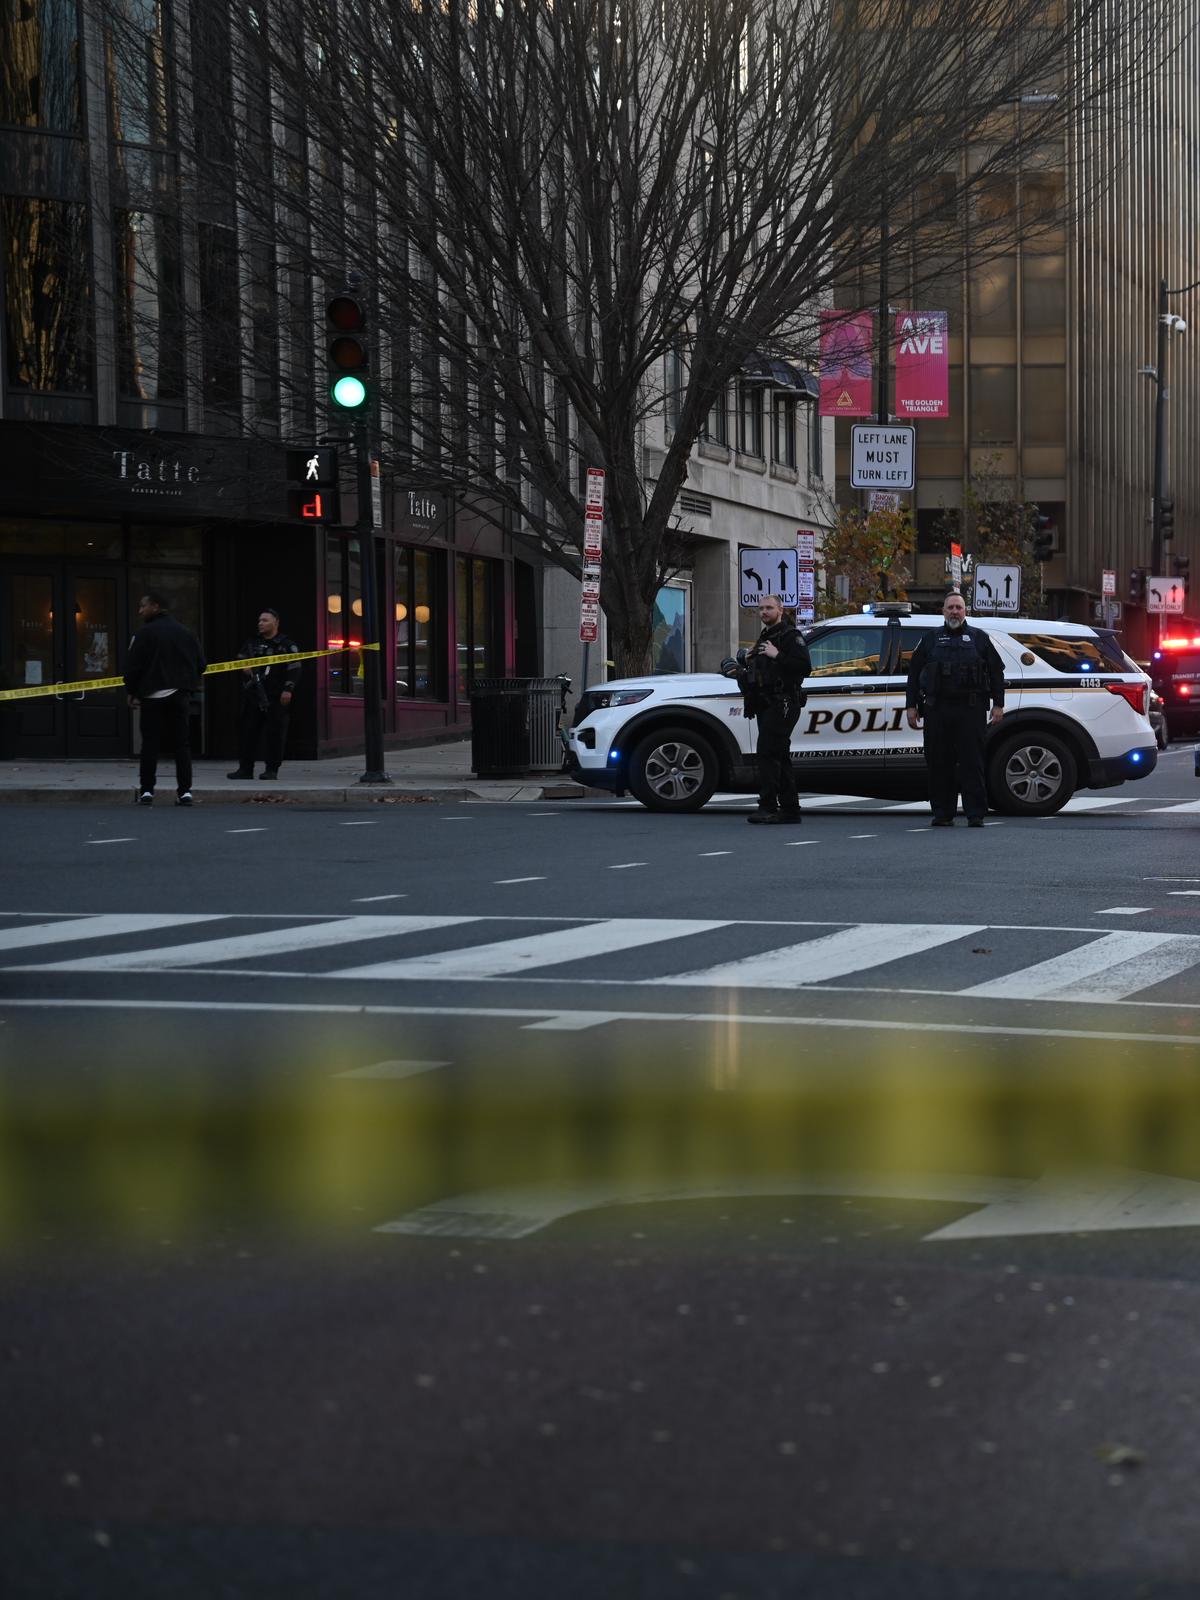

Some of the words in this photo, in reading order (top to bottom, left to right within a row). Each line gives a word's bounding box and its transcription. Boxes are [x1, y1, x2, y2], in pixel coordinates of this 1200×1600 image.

[900, 317, 945, 336] ART
[900, 336, 943, 354] AVE
[858, 433, 880, 444] LEFT
[884, 434, 908, 445] LANE
[866, 450, 899, 463] MUST
[113, 451, 200, 484] Tatte
[857, 469, 882, 480] TURN
[886, 470, 908, 481] LEFT
[408, 491, 437, 519] Tatte
[976, 599, 997, 608] ONLY
[997, 600, 1016, 609] ONLY
[1080, 678, 1101, 688] 4143
[855, 748, 893, 756] SECRET
